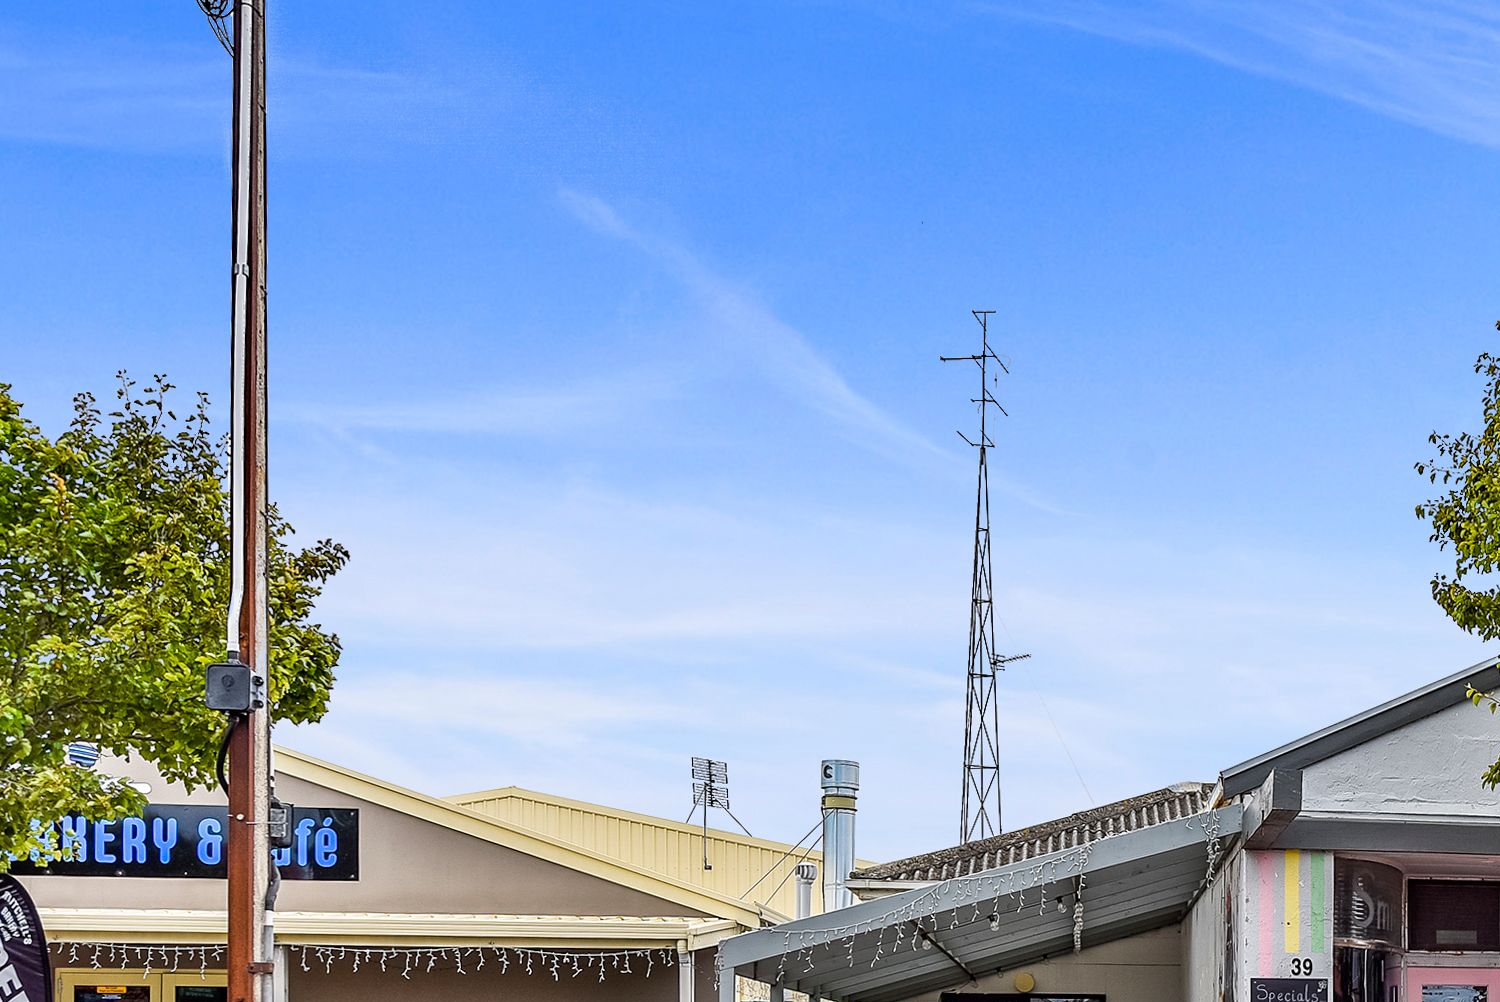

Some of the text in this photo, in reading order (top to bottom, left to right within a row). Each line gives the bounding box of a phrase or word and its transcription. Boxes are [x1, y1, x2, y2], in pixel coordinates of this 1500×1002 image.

[4, 815, 338, 868] AKERY & fé
[1291, 957, 1313, 976] 39
